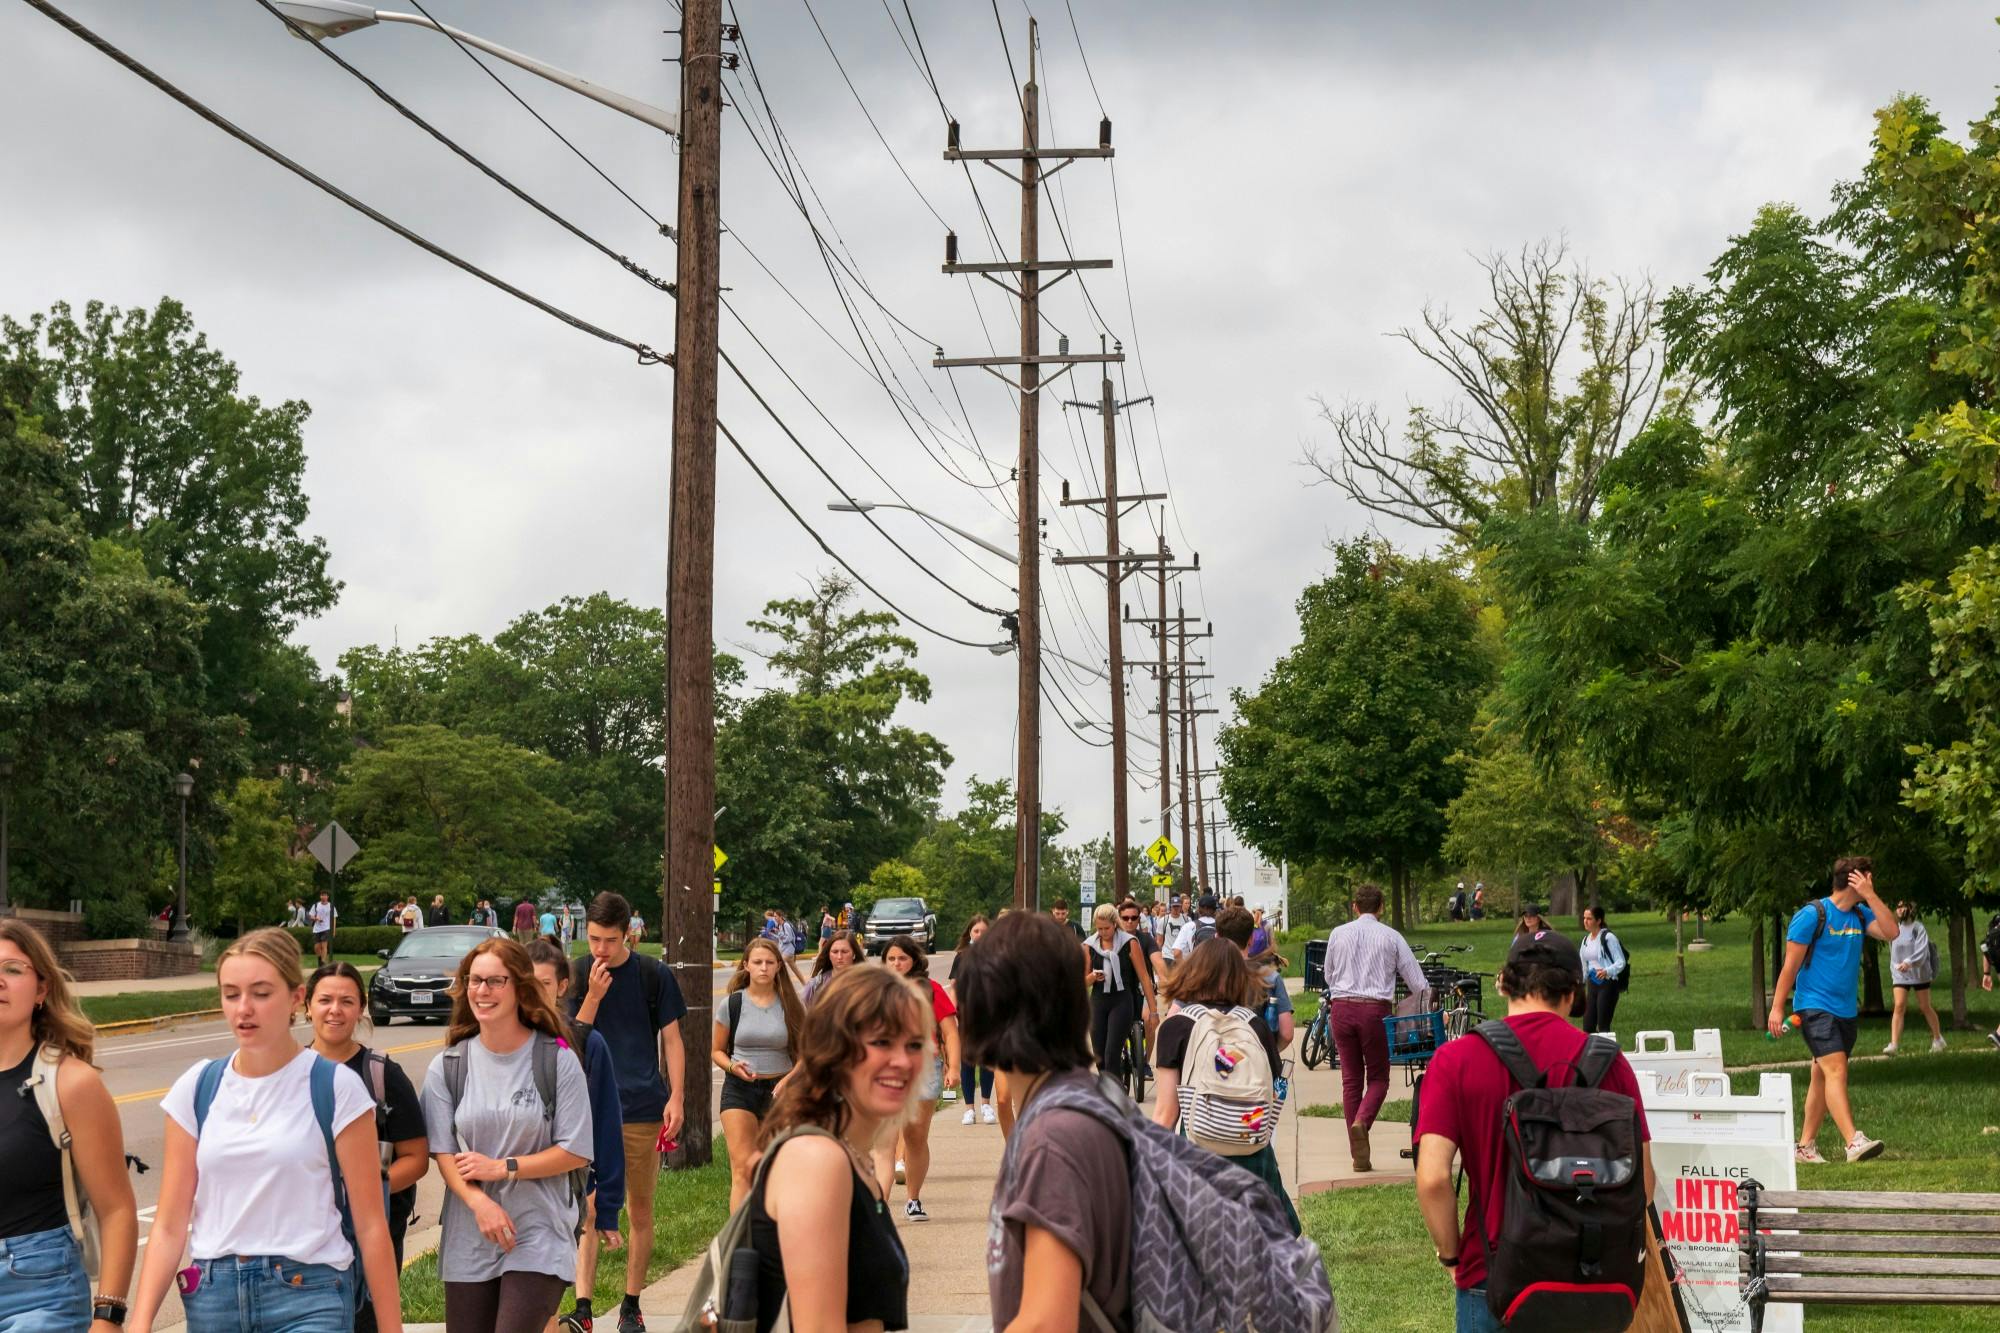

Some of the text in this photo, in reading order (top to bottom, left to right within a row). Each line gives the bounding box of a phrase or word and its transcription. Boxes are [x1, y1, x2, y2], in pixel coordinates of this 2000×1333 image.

[1681, 1165, 1749, 1178] FALL ICE
[1675, 1178, 1740, 1212] INTR
[1662, 1210, 1740, 1244] MURA
[1688, 1245, 1736, 1253] BROOMBALL
